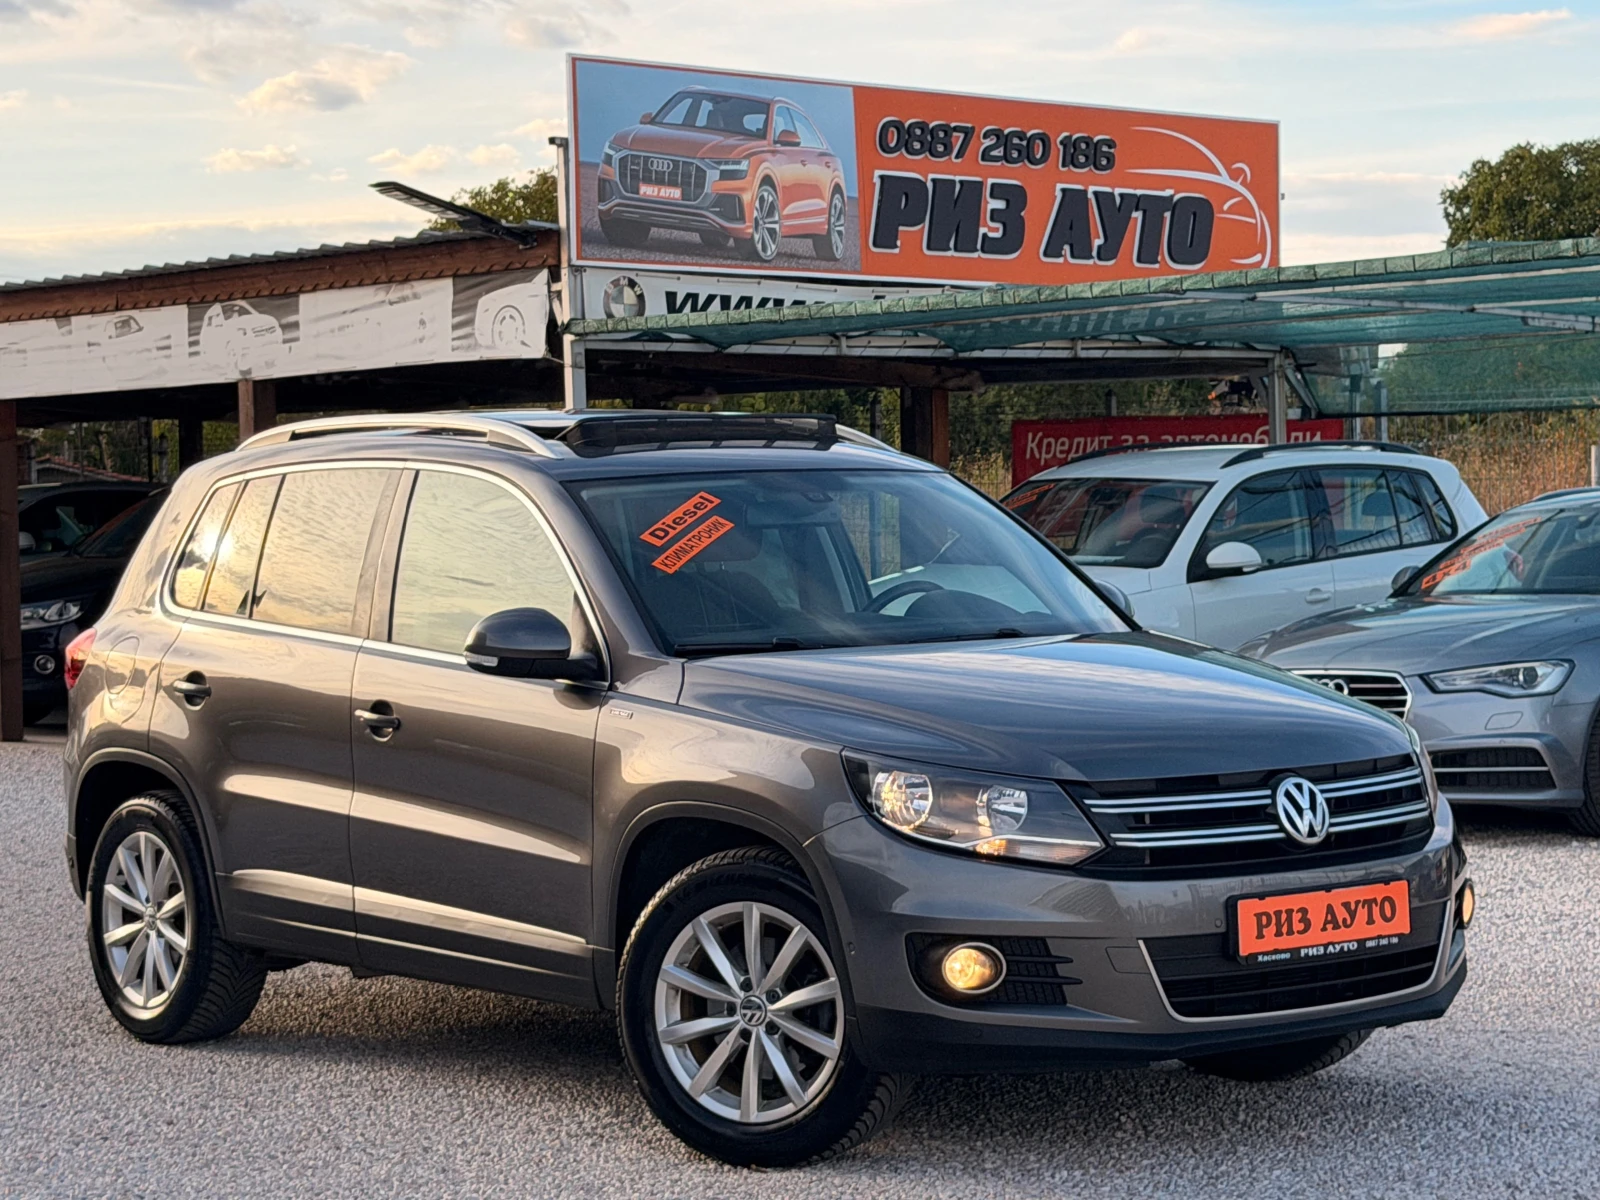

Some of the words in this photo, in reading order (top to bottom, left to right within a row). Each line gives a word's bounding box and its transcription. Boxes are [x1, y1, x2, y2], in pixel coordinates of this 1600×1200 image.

[877, 117, 975, 162] 0887
[979, 126, 1051, 168] 260
[1057, 132, 1117, 173] 186
[870, 170, 1028, 259] РИЗ
[1039, 183, 1214, 270] АУТО
[1025, 432, 1113, 466] Кредит
[649, 495, 715, 541] Diesel
[659, 518, 729, 569] КЛИМАТРОНИК
[1253, 907, 1312, 940] РИЗ
[1320, 896, 1397, 932] АУТО
[1300, 943, 1325, 958] РИЗ
[1326, 941, 1358, 954] АУТО
